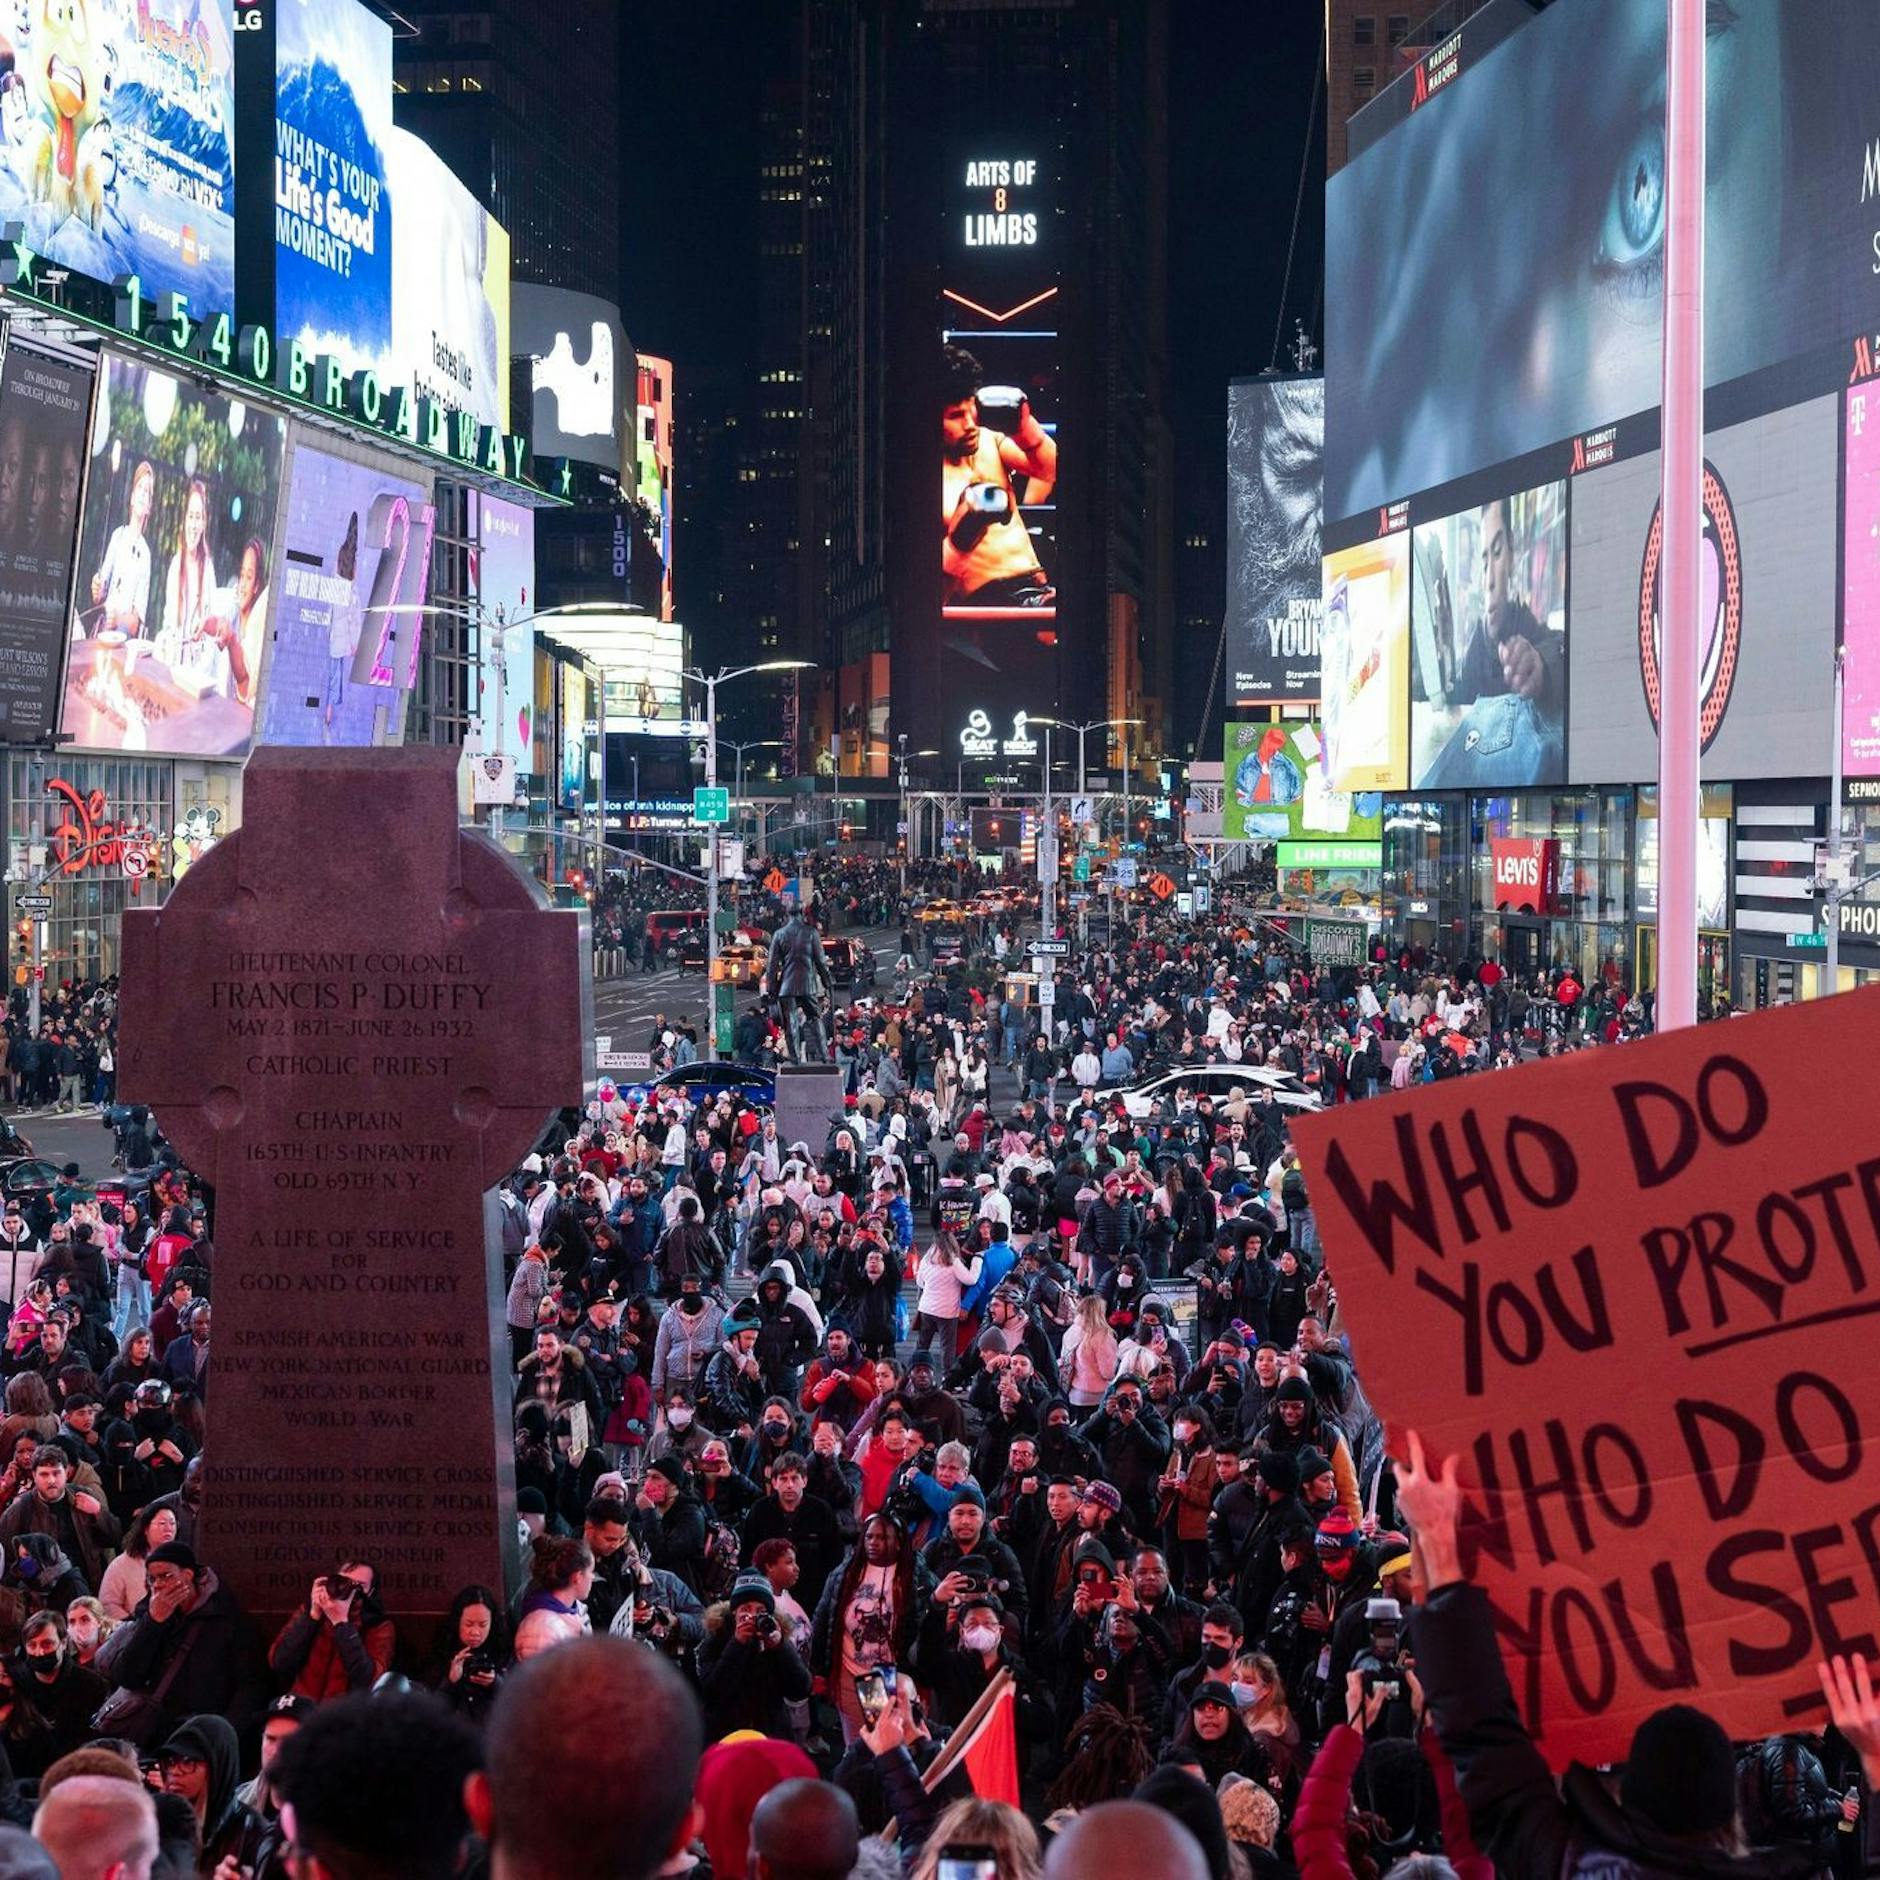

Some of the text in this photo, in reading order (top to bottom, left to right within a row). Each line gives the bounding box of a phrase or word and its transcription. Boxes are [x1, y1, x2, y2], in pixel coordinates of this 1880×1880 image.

[233, 10, 263, 31] LG
[276, 118, 338, 187] WHAT'S
[341, 158, 379, 212] YOUR
[966, 160, 1036, 186] ARTS OF
[276, 155, 323, 227] Life's
[326, 188, 374, 255] Good
[995, 187, 1006, 212] 8
[966, 213, 1037, 246] LIMBS
[276, 207, 352, 279] MOMENT?
[432, 329, 458, 380] Tastes
[126, 275, 526, 480] 1540 BROADWAY
[613, 515, 626, 577] 1500
[1236, 672, 1254, 681] New
[1236, 681, 1272, 691] Episodes
[1120, 869, 1133, 879] 25
[1311, 924, 1361, 935] DISCOVER
[229, 953, 470, 974] LIEUTENANT COLONEL
[1311, 954, 1360, 966] SECRETS
[211, 982, 340, 1010] FRANCIS
[384, 982, 492, 1010] DUFFY
[226, 1020, 268, 1036] MAY
[275, 1020, 285, 1036] 2
[403, 1020, 423, 1037] 26
[431, 1020, 473, 1037] 1932
[246, 1056, 453, 1077] CATHOLIC PRIEST
[295, 1111, 402, 1130] CHAPLAIN
[247, 1144, 304, 1161] 165TH
[357, 1144, 453, 1162] INFANTRY
[1325, 1055, 1768, 1275] WHO DO
[273, 1172, 318, 1190] OLD
[325, 1173, 374, 1190] 69TH
[251, 1230, 455, 1249] A LIFE OF SERVICE
[331, 1254, 367, 1269] FOR
[239, 1274, 461, 1293] GOD AND COUNTRY
[1416, 1245, 1615, 1396] YOU
[234, 1331, 465, 1347] SPANISH AMERICAN WAR
[210, 1357, 490, 1375] NEW YORK NATIONAL GUARD
[263, 1384, 436, 1400] MEXICAN BORDER
[285, 1410, 415, 1428] WORLD WAR
[1675, 1372, 1862, 1521] DO
[204, 1466, 494, 1483] DISTINGUISHED SERVICE CROSS
[204, 1493, 493, 1510] DISTINGUISHED SERVICE MEDAL
[204, 1519, 494, 1537] CONSPICUOUS SERVICE CROSS
[1488, 1561, 1698, 1741] YOU
